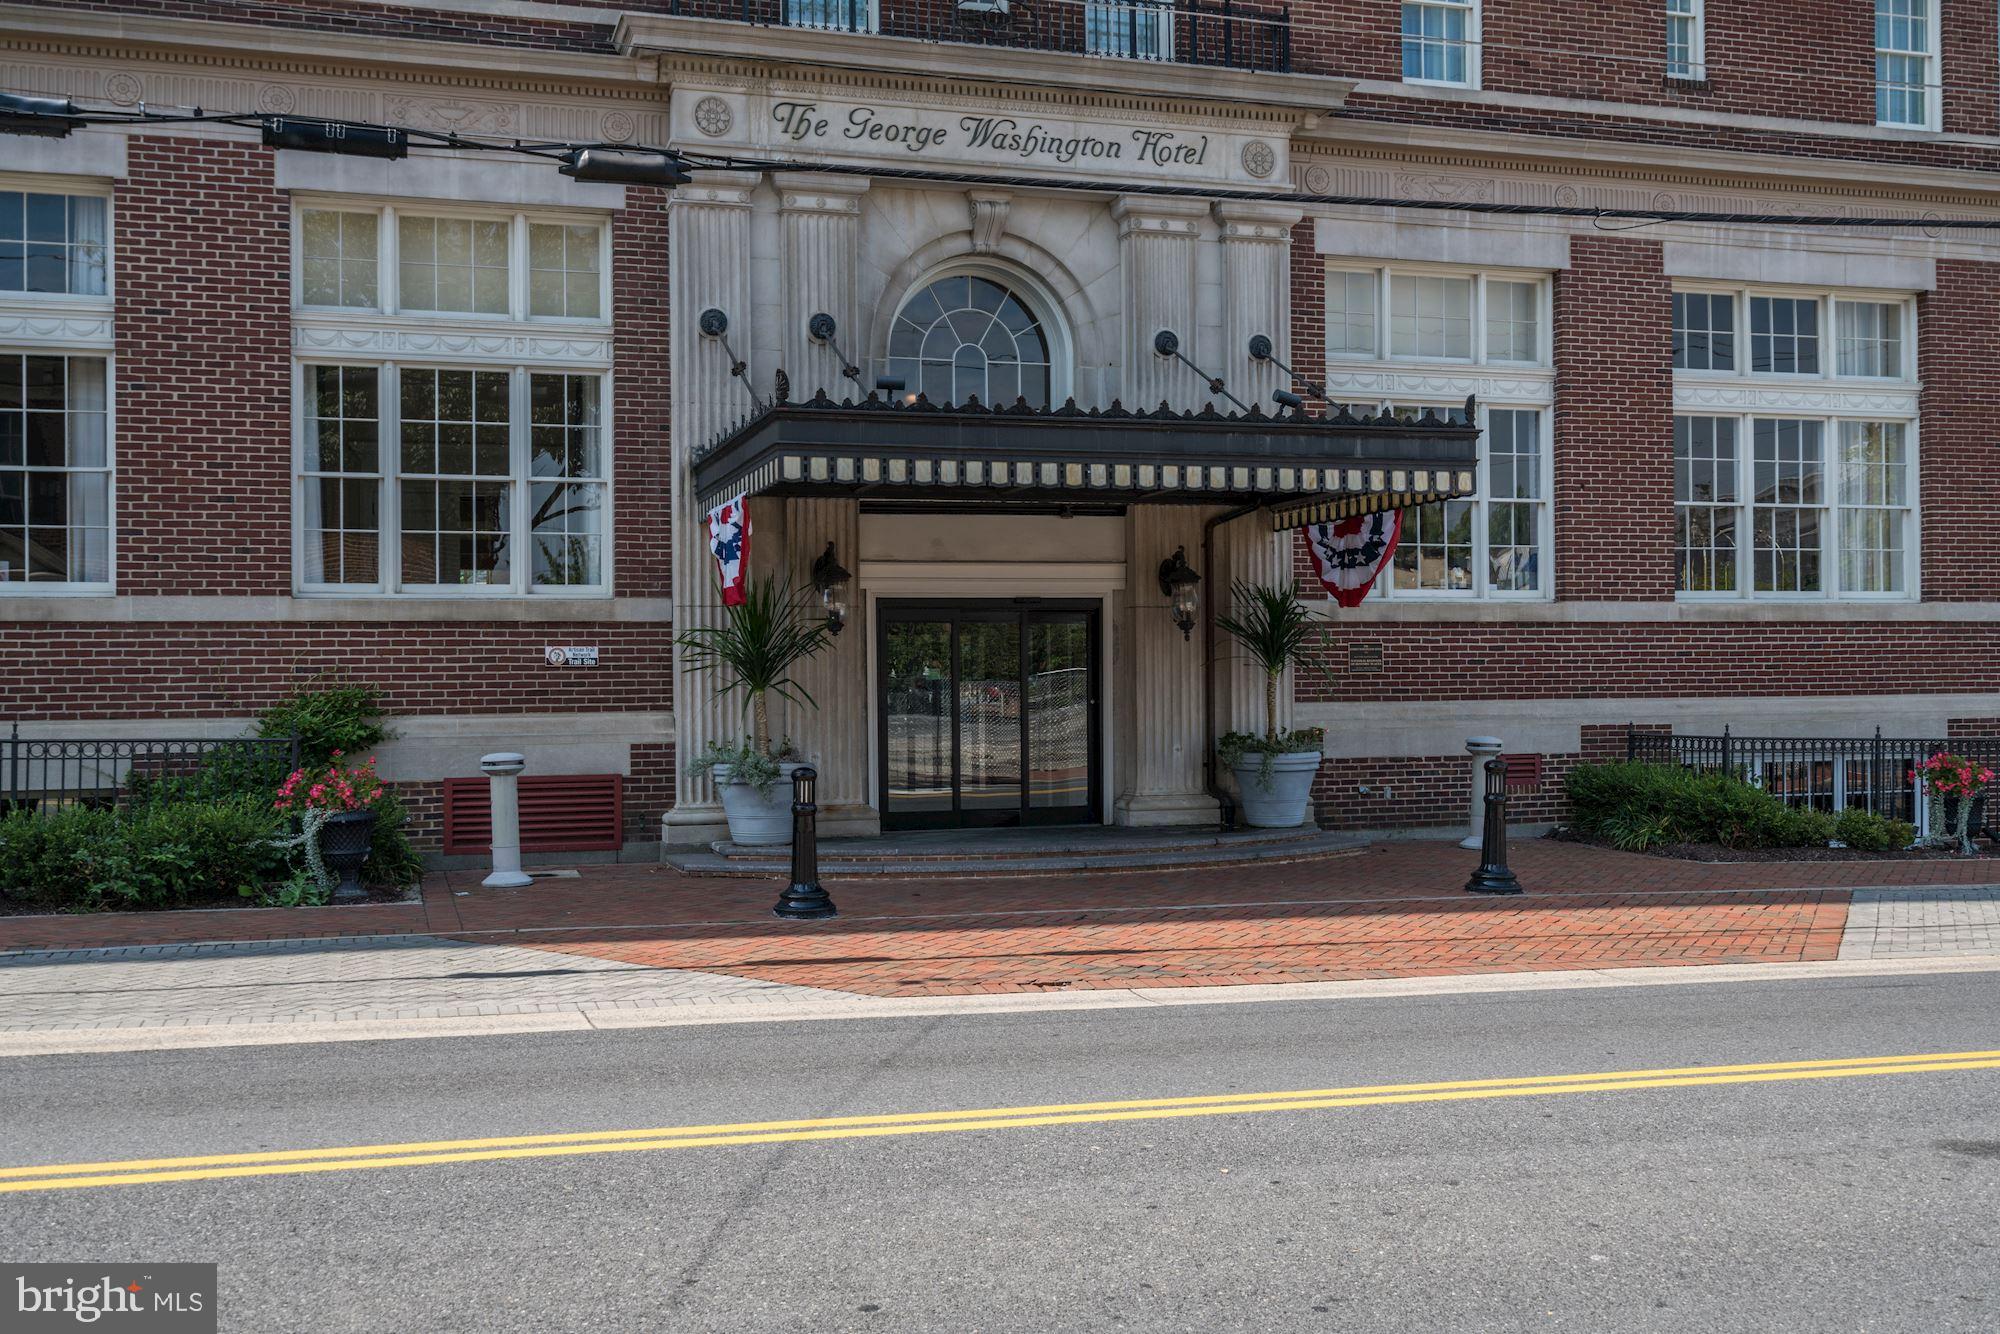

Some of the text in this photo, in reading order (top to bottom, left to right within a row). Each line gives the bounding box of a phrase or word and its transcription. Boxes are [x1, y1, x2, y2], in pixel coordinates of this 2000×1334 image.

[773, 102, 1208, 167] The George Washington Hotel
